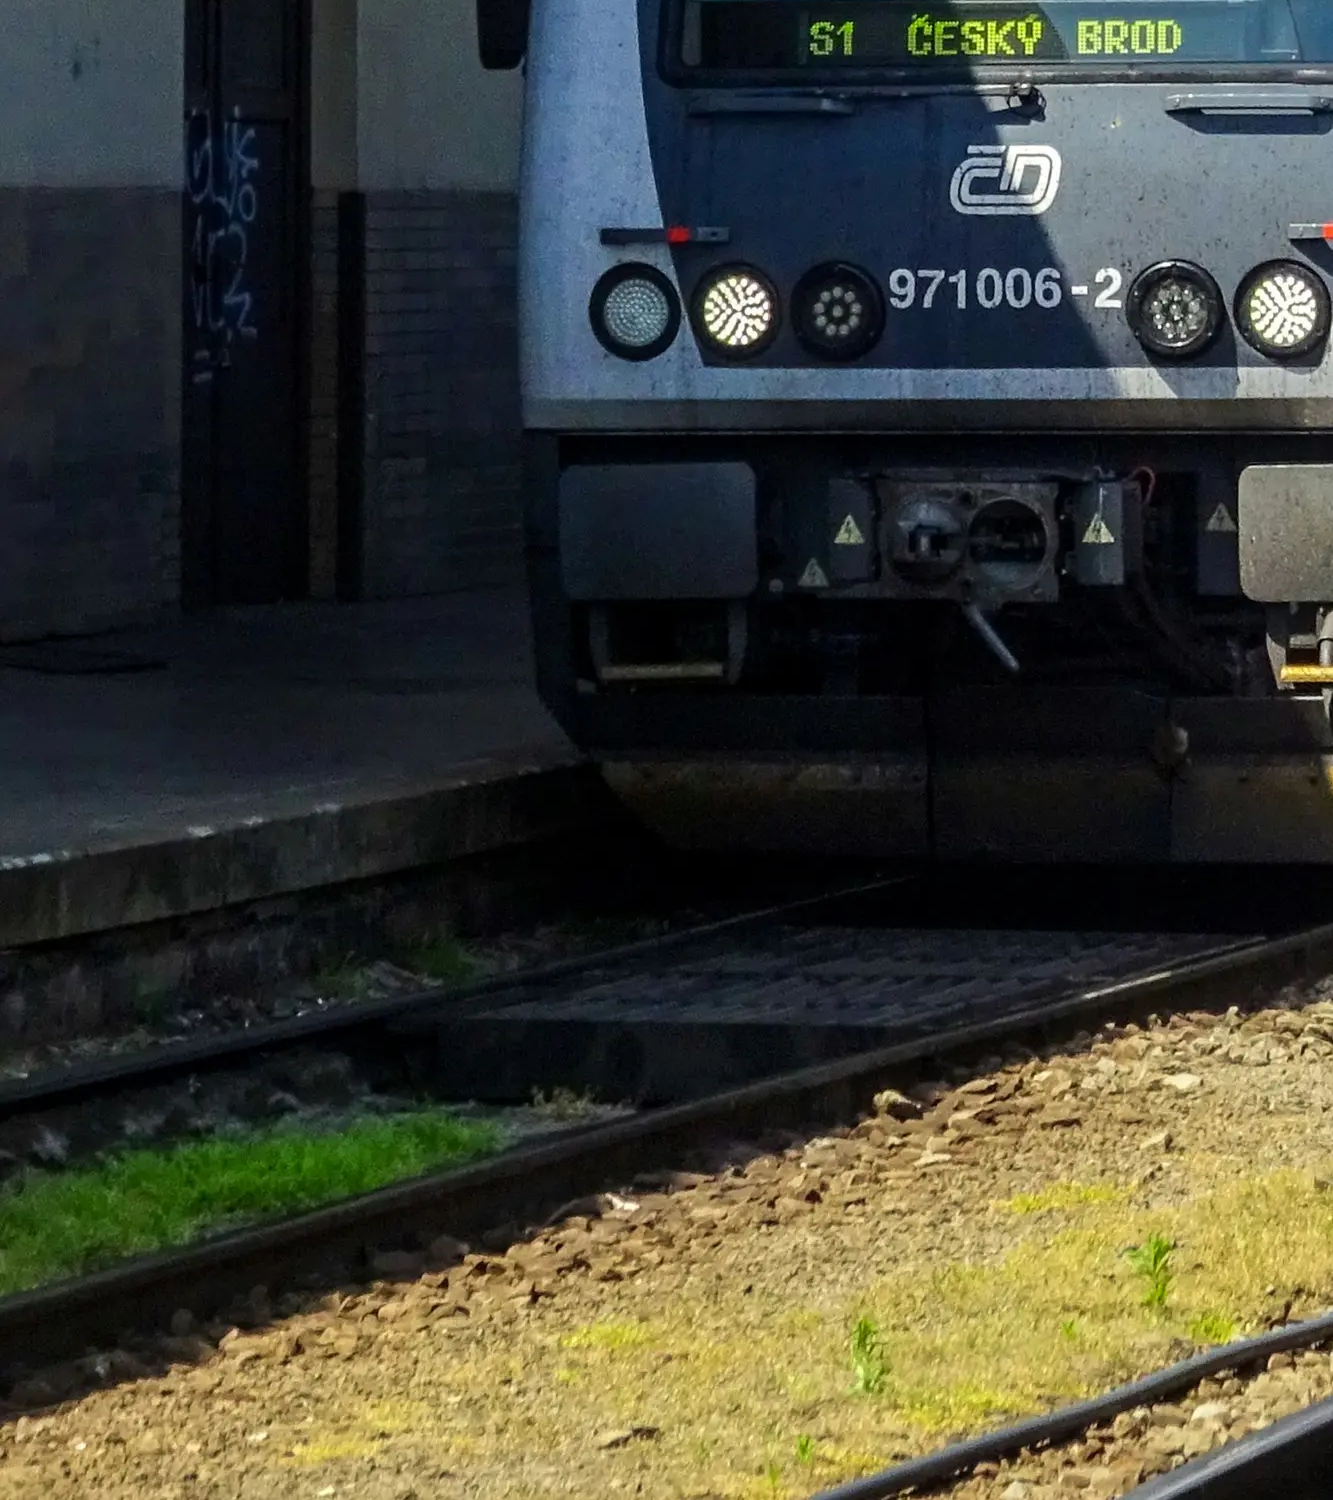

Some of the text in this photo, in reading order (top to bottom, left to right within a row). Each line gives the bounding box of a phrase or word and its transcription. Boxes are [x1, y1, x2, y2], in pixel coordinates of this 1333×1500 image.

[809, 13, 1182, 56] S1 ČESKÝ BROD
